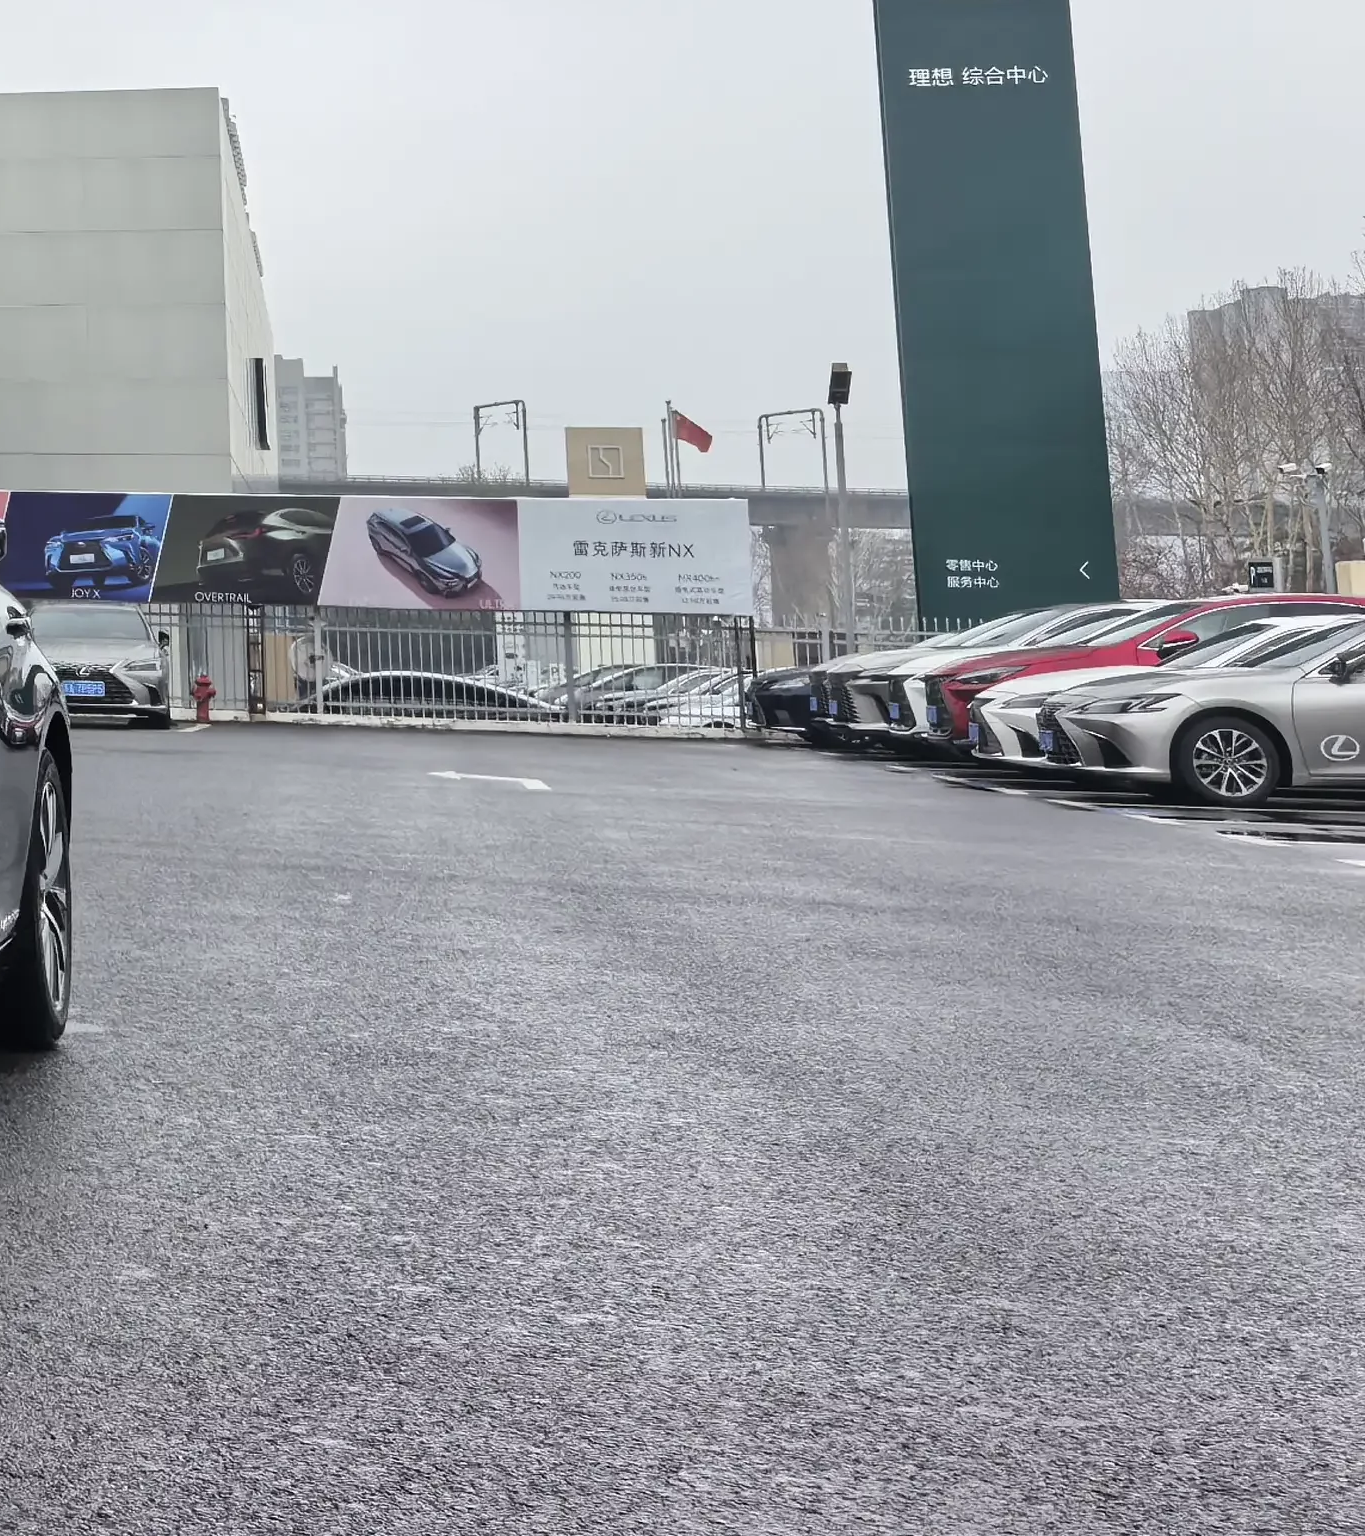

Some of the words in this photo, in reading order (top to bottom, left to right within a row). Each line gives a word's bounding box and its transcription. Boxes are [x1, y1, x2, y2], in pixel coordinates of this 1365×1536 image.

[908, 67, 954, 87] 理想
[961, 65, 1049, 86] 综合中心
[619, 513, 678, 524] LEXUS
[573, 539, 696, 559] 雷克萨斯新NX
[945, 559, 999, 572] 零售中心
[946, 575, 1000, 588] 服务中心
[71, 588, 90, 599] JOY
[92, 589, 101, 599] X
[194, 591, 252, 604] OVERTRAIL
